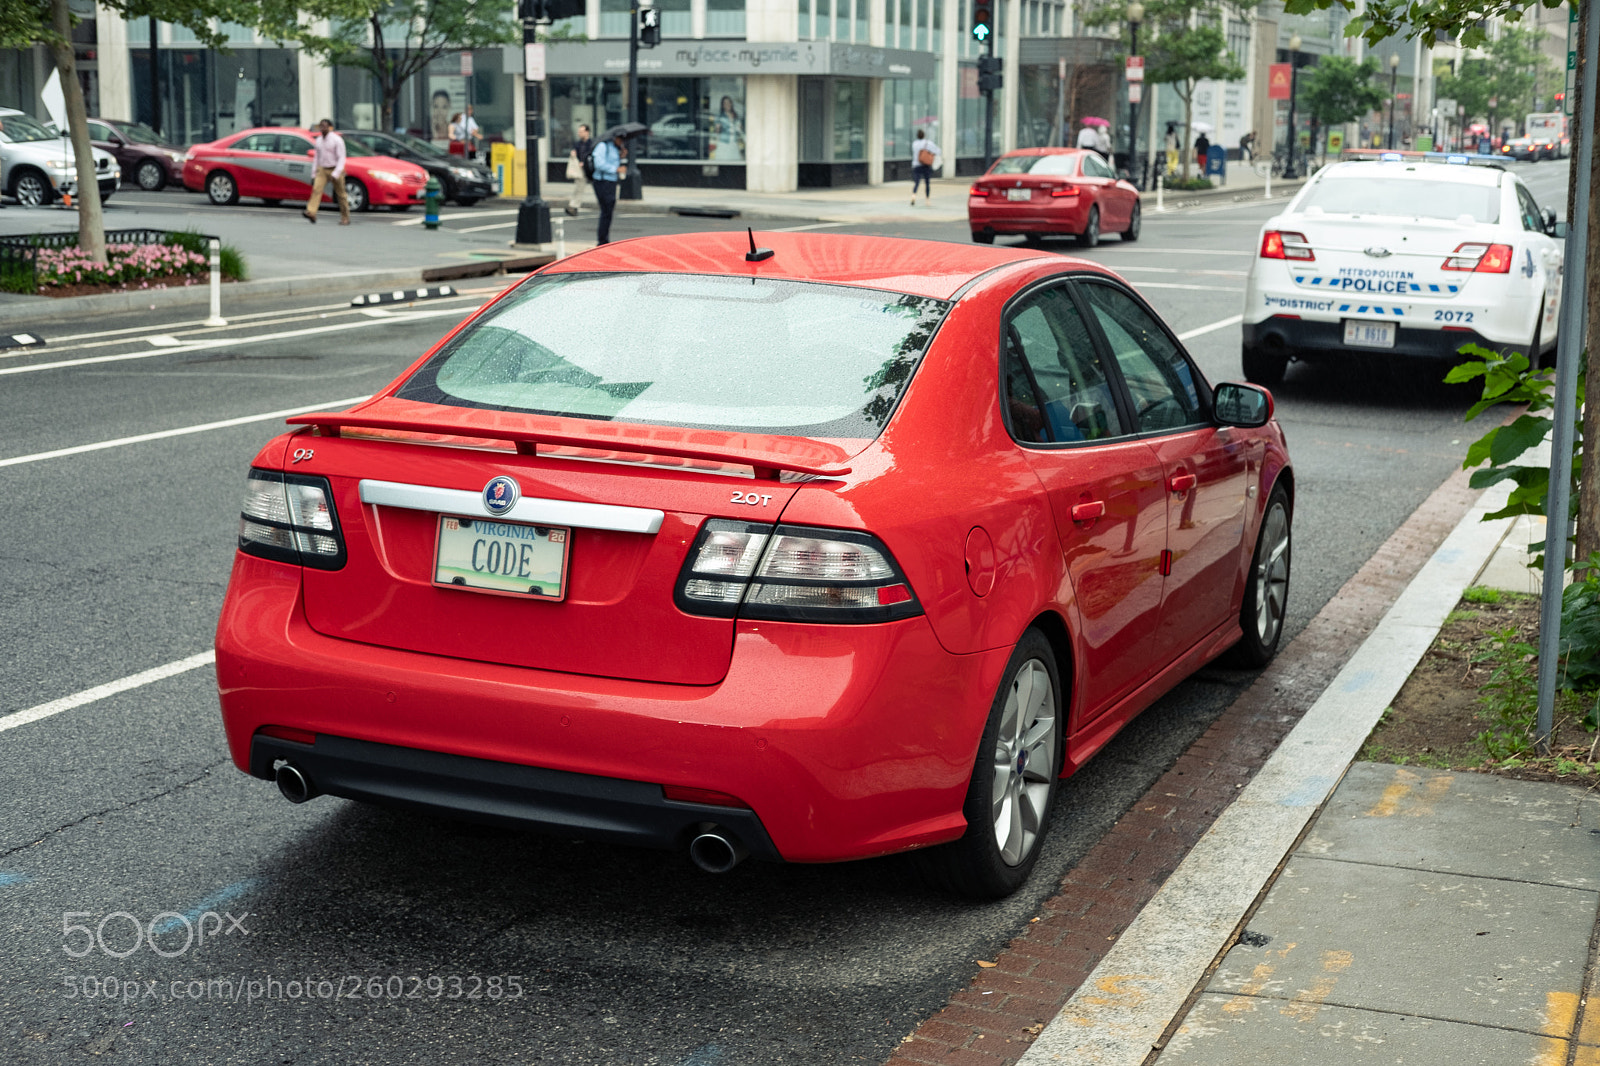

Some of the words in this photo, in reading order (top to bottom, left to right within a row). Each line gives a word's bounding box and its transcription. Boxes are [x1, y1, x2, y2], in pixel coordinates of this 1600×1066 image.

[676, 46, 730, 67] myface
[739, 46, 798, 67] mysmile
[1339, 267, 1414, 279] METROPOLITAN
[1342, 277, 1407, 293] POLICE
[1434, 310, 1474, 323] 2072
[292, 448, 314, 464] 93
[446, 520, 458, 530] FEB
[474, 520, 536, 540] VIRGINIA
[551, 533, 565, 543] 20
[472, 539, 533, 578] CODE
